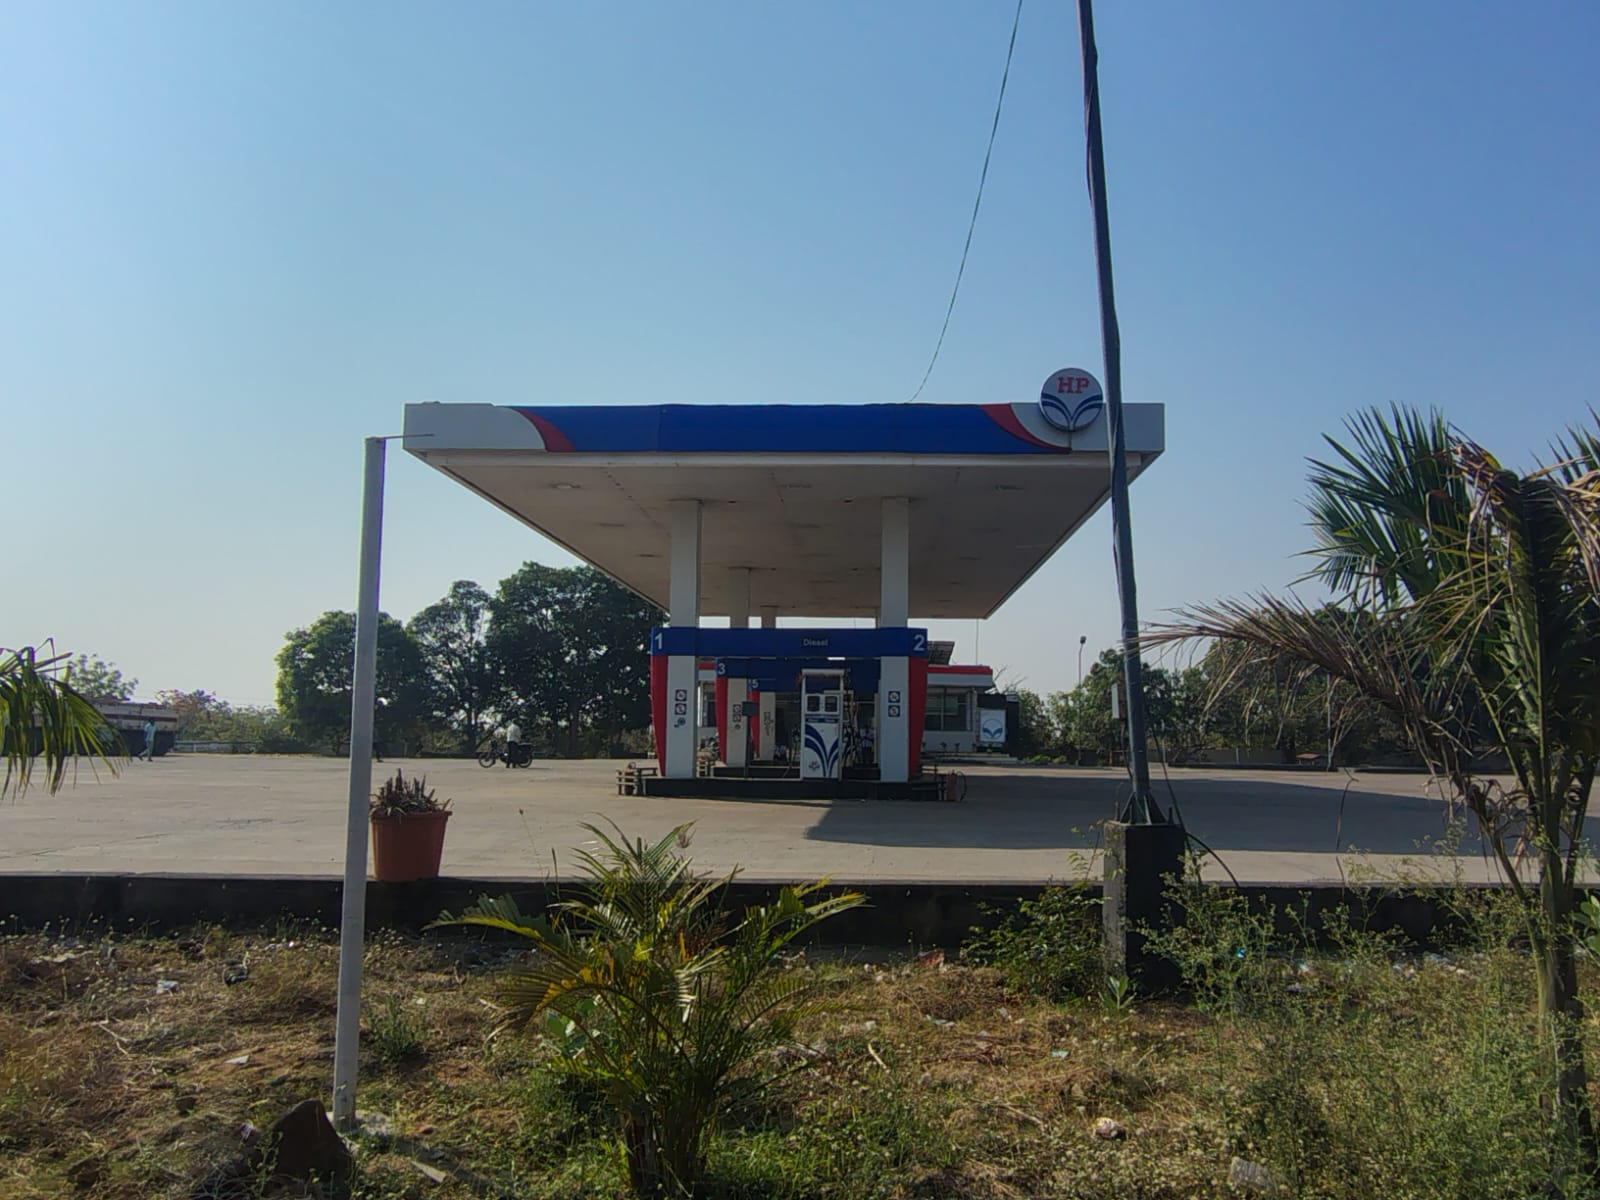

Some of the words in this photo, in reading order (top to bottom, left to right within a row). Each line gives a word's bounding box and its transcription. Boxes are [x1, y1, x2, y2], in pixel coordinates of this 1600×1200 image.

[1057, 377, 1089, 393] HP
[655, 632, 663, 649] 1
[803, 638, 829, 646] Diesel
[913, 634, 925, 651] 2
[718, 663, 726, 675] 3
[751, 679, 759, 688] 5
